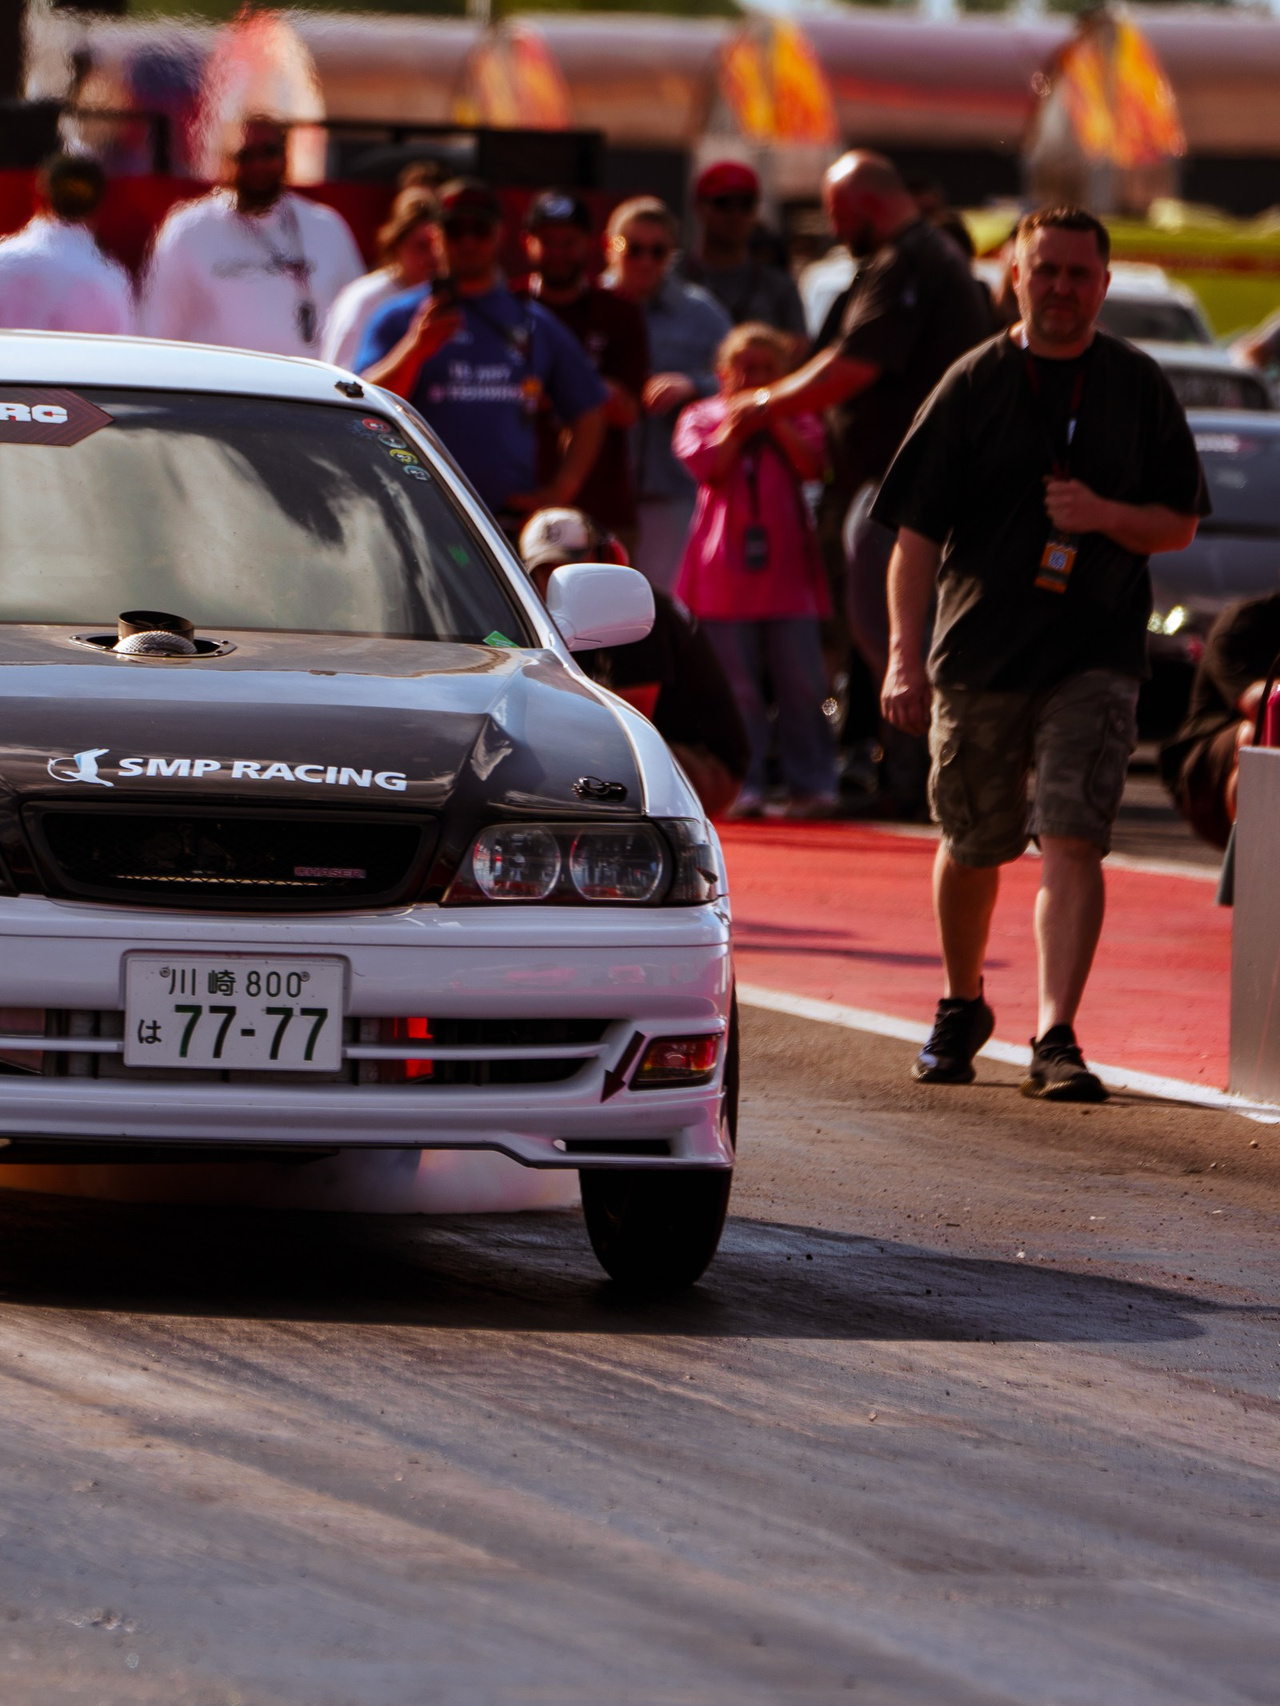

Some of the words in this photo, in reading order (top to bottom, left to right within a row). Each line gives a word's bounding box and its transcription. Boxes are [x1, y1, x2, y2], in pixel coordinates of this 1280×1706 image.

[118, 757, 221, 778] SMP
[231, 760, 408, 791] RACING
[294, 866, 365, 879] CHASER
[169, 968, 237, 997] 川崎
[246, 970, 302, 998] 800
[137, 1018, 162, 1045] は
[174, 1004, 329, 1062] 77-77
